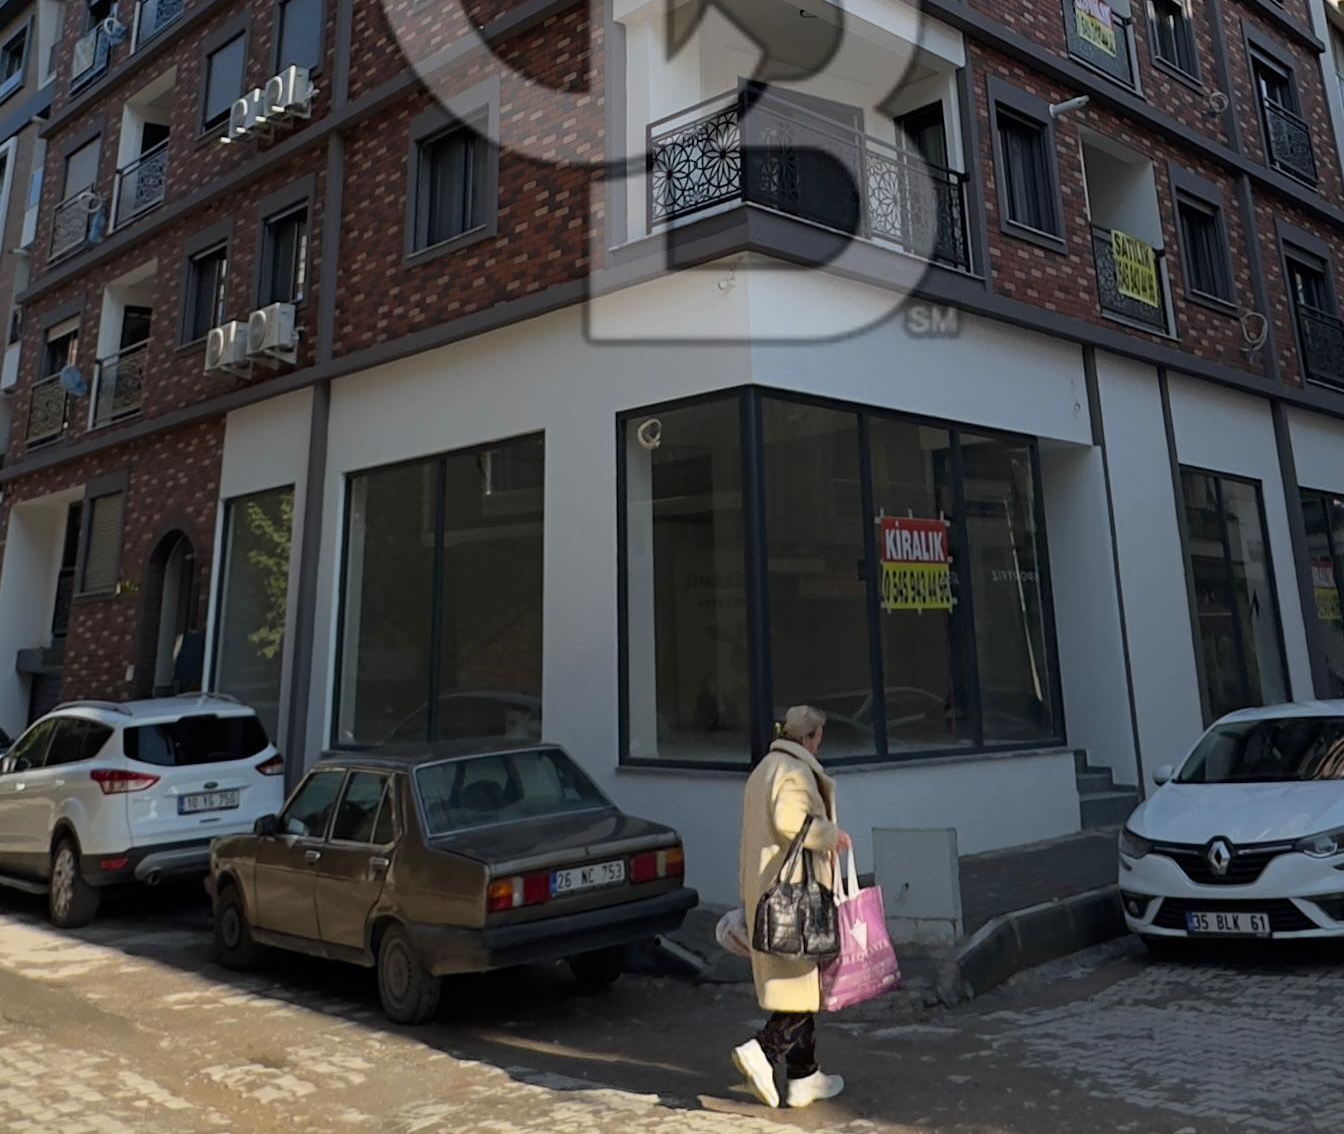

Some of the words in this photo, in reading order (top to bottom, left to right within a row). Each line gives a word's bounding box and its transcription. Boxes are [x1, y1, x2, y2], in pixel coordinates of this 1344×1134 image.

[885, 521, 945, 562] KİRALIK
[557, 871, 572, 889] 26
[1192, 913, 1209, 931] 35
[1216, 913, 1241, 932] BLK
[1249, 914, 1266, 932] 61
